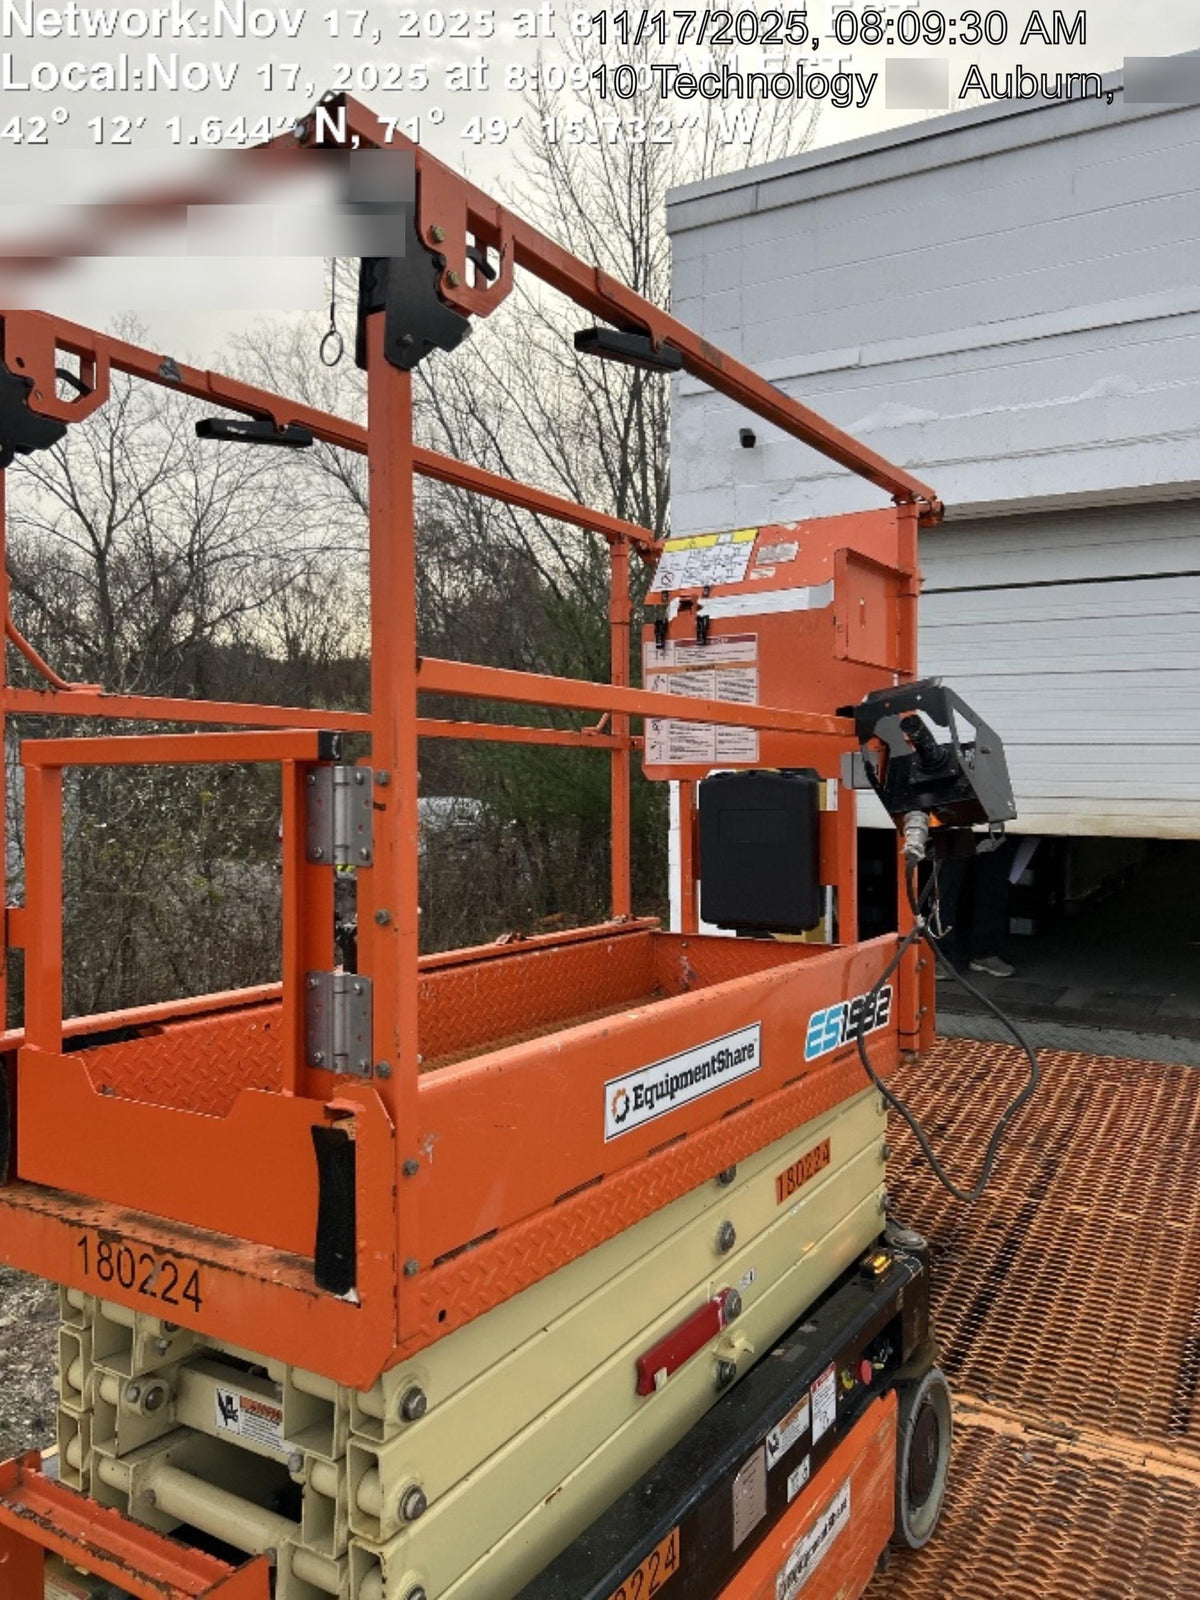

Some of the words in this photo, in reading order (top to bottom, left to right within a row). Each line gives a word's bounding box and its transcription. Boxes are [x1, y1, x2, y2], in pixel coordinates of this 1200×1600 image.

[632, 1041, 756, 1111] EquipmentShare
[778, 1142, 830, 1202] 180224
[77, 1235, 203, 1313] 180224
